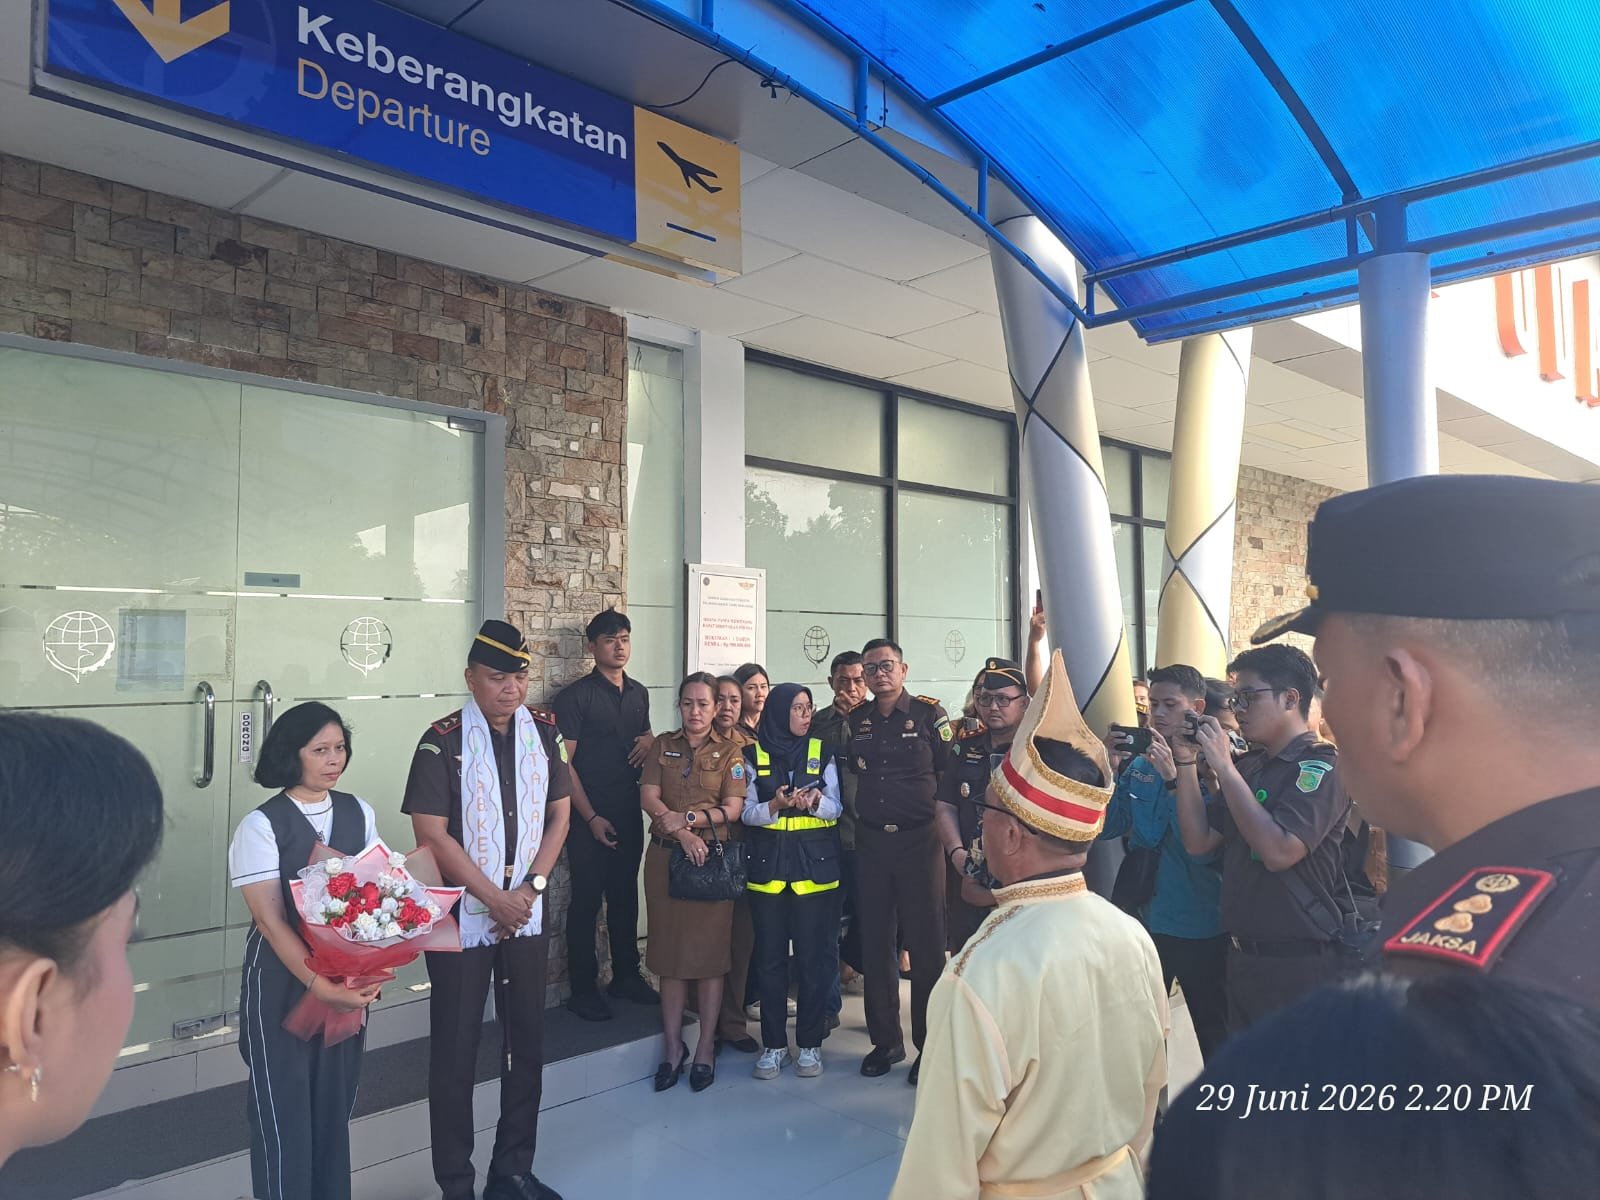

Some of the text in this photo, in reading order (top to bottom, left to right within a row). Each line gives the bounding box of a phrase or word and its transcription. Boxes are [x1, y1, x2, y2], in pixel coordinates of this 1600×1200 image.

[298, 6, 627, 160] Keberangkatan
[298, 57, 491, 156] Departure
[242, 714, 250, 752] DORONG
[1400, 931, 1477, 955] JAKSA
